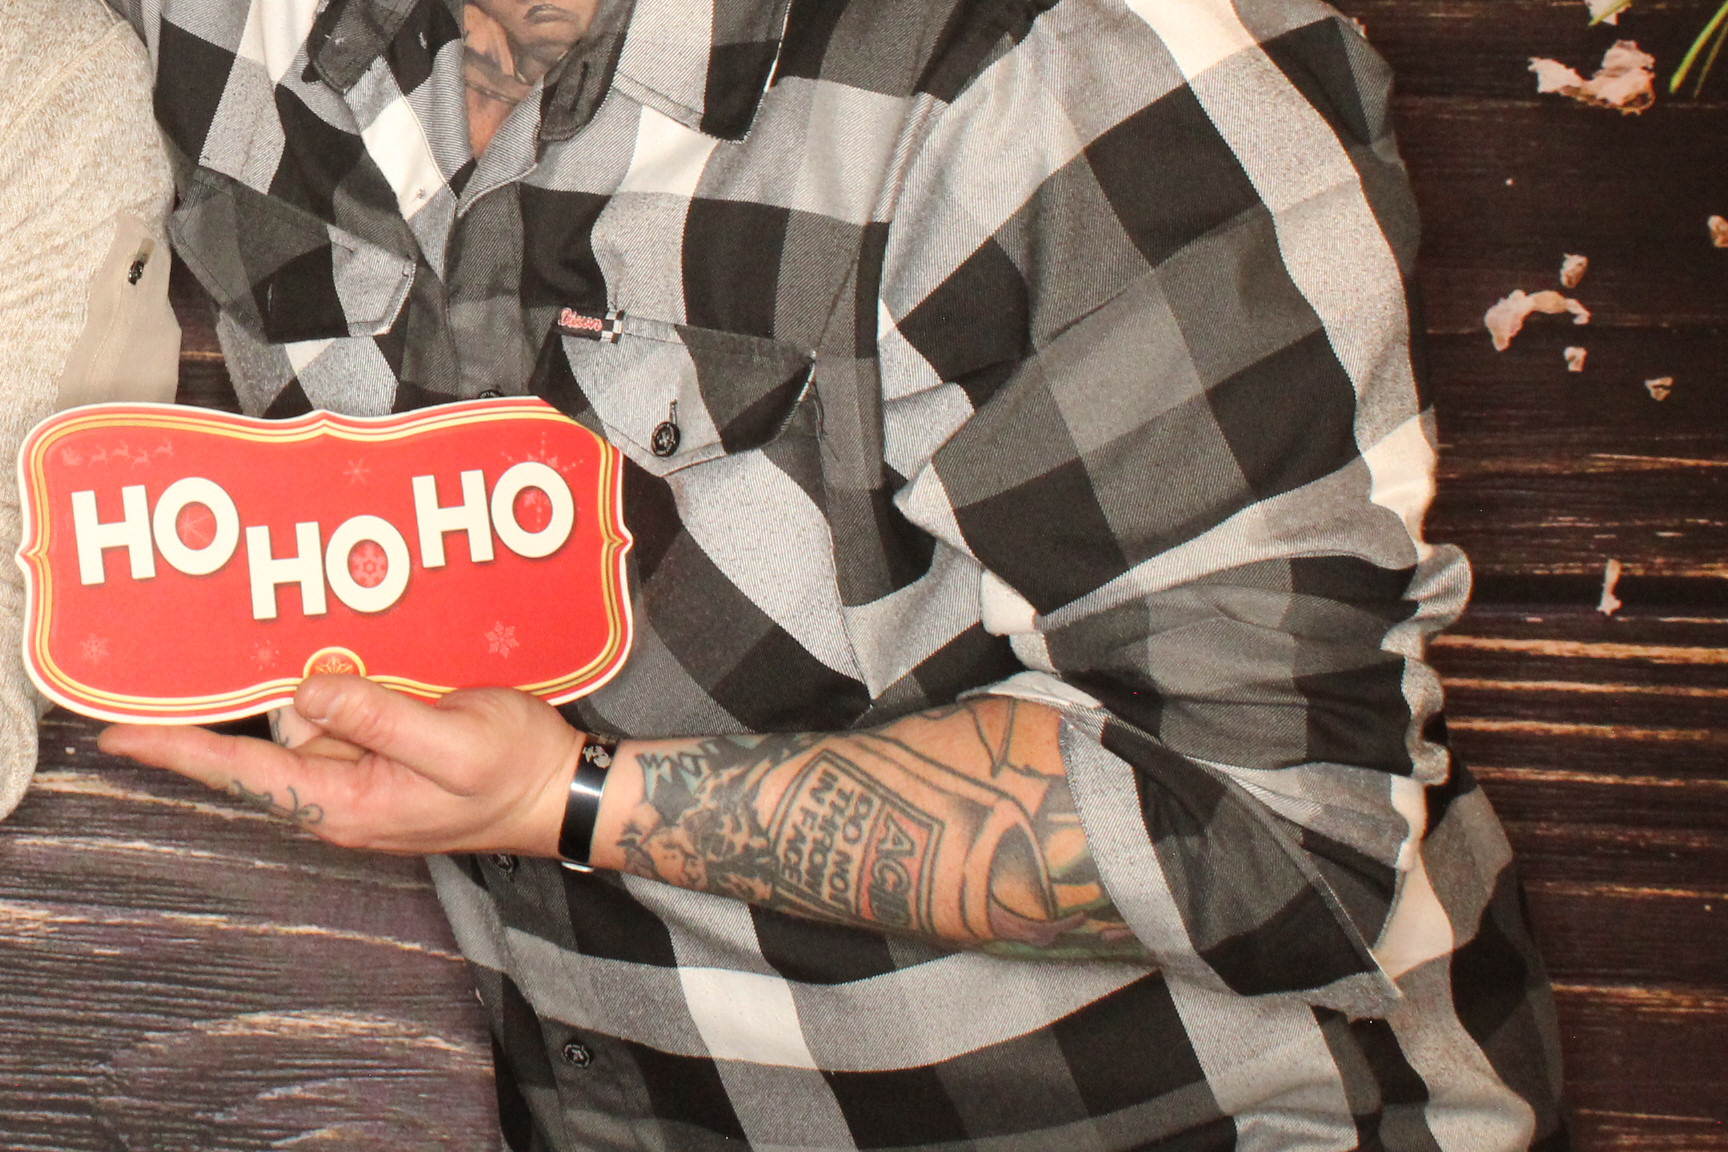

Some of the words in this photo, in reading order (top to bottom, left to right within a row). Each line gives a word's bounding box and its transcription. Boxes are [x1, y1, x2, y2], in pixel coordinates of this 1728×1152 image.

[810, 769, 839, 805] IN
[842, 793, 873, 845] DO
[781, 806, 819, 883] FACE
[803, 788, 855, 894] THROW
[869, 810, 917, 926] ACID
[827, 849, 855, 912] NOT
